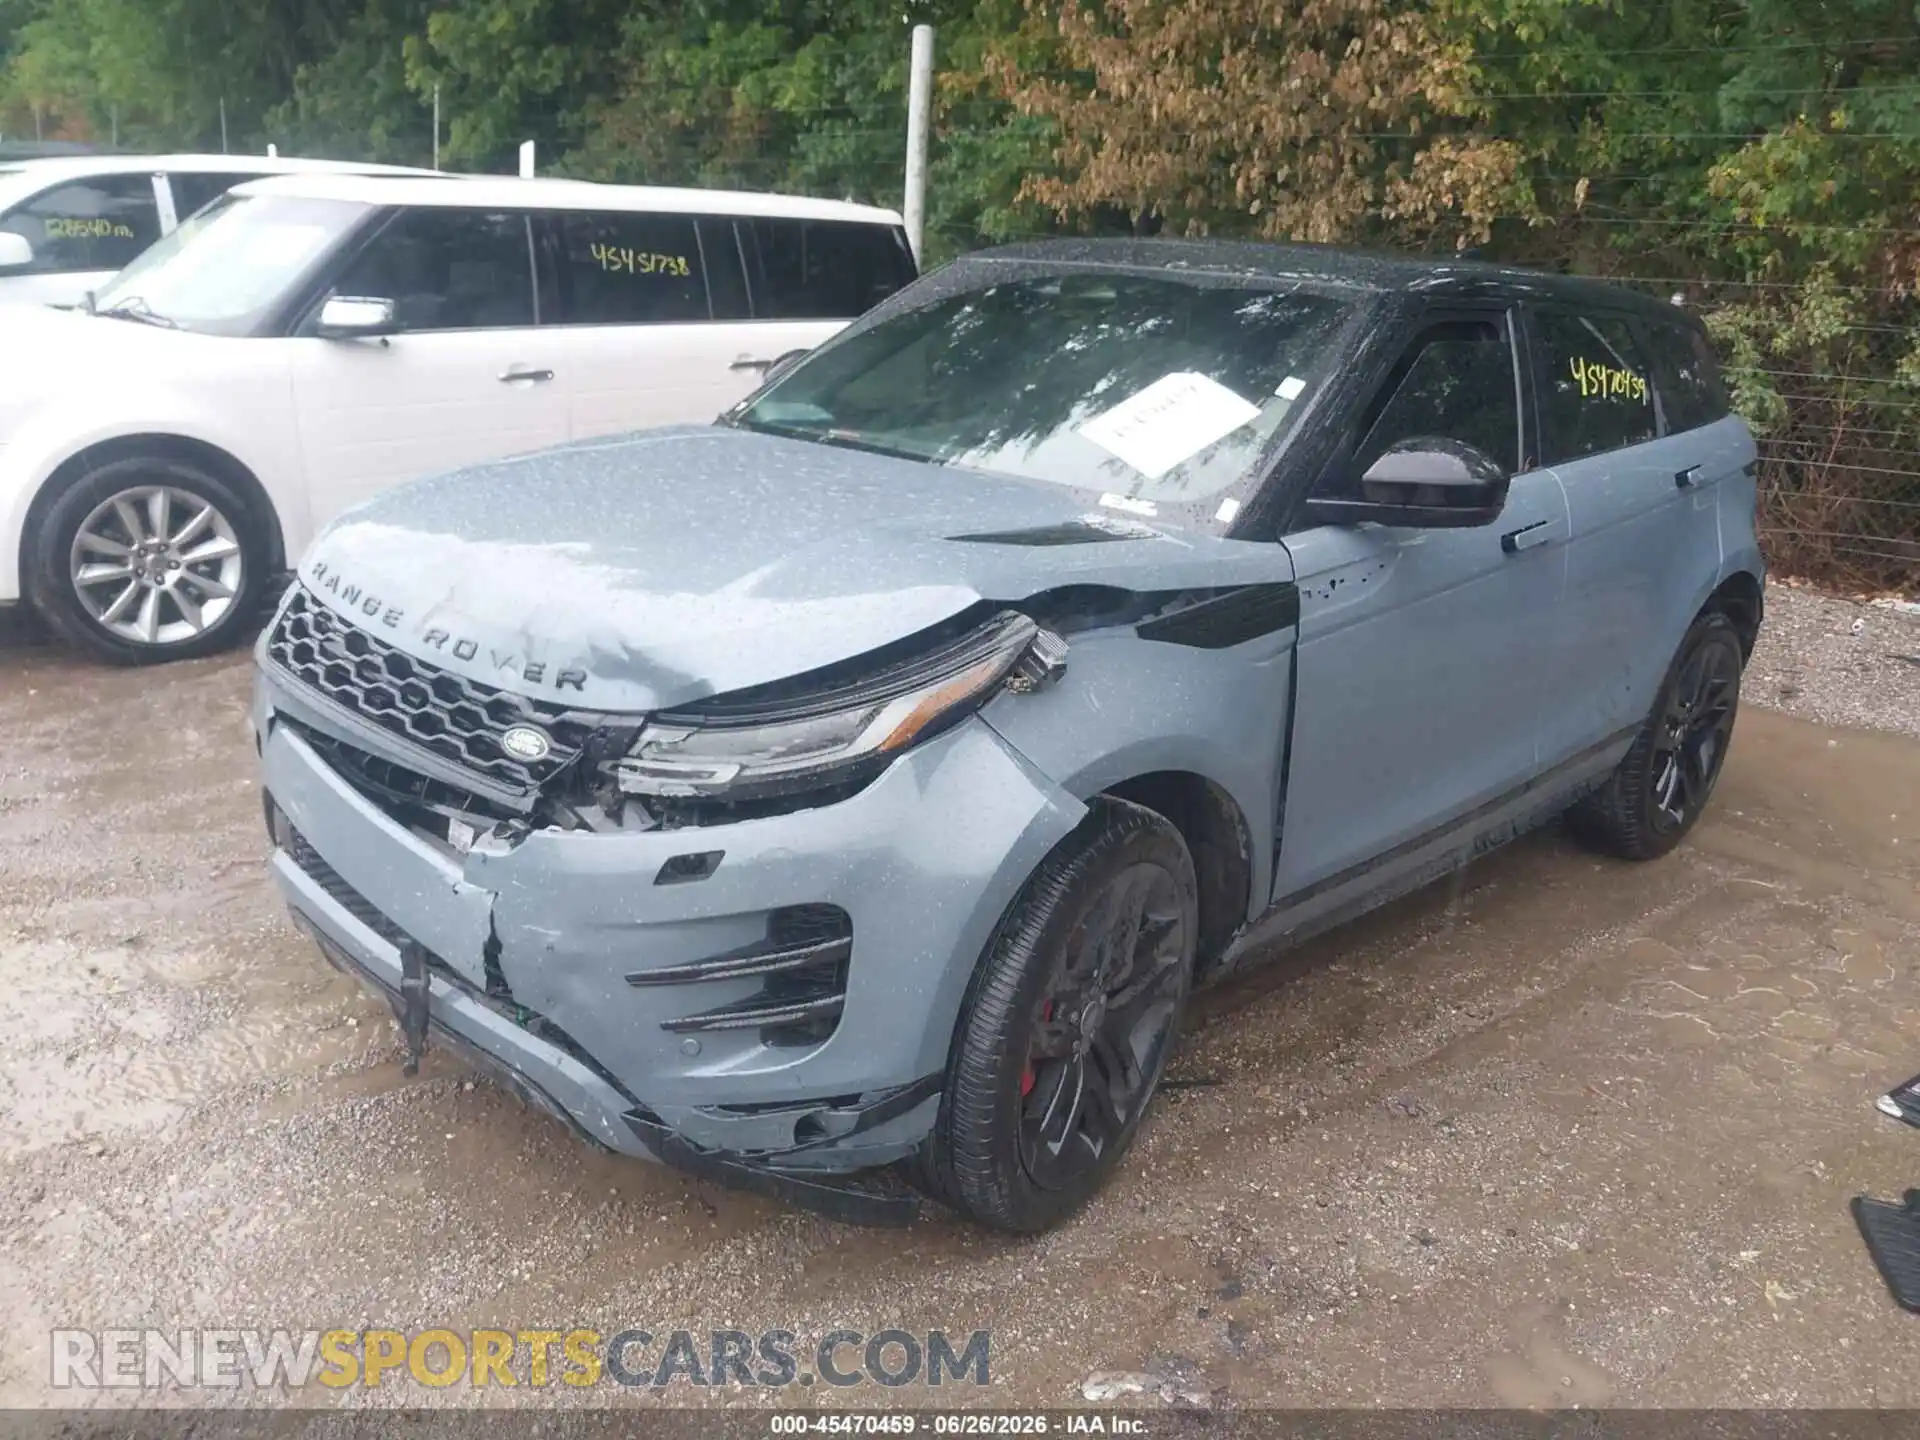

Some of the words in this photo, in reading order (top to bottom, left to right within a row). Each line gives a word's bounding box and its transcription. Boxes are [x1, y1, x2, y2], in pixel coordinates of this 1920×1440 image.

[590, 242, 691, 277] 45451738
[1569, 356, 1647, 406] 45470459
[311, 562, 404, 629] RANGE
[422, 628, 589, 692] ROVER
